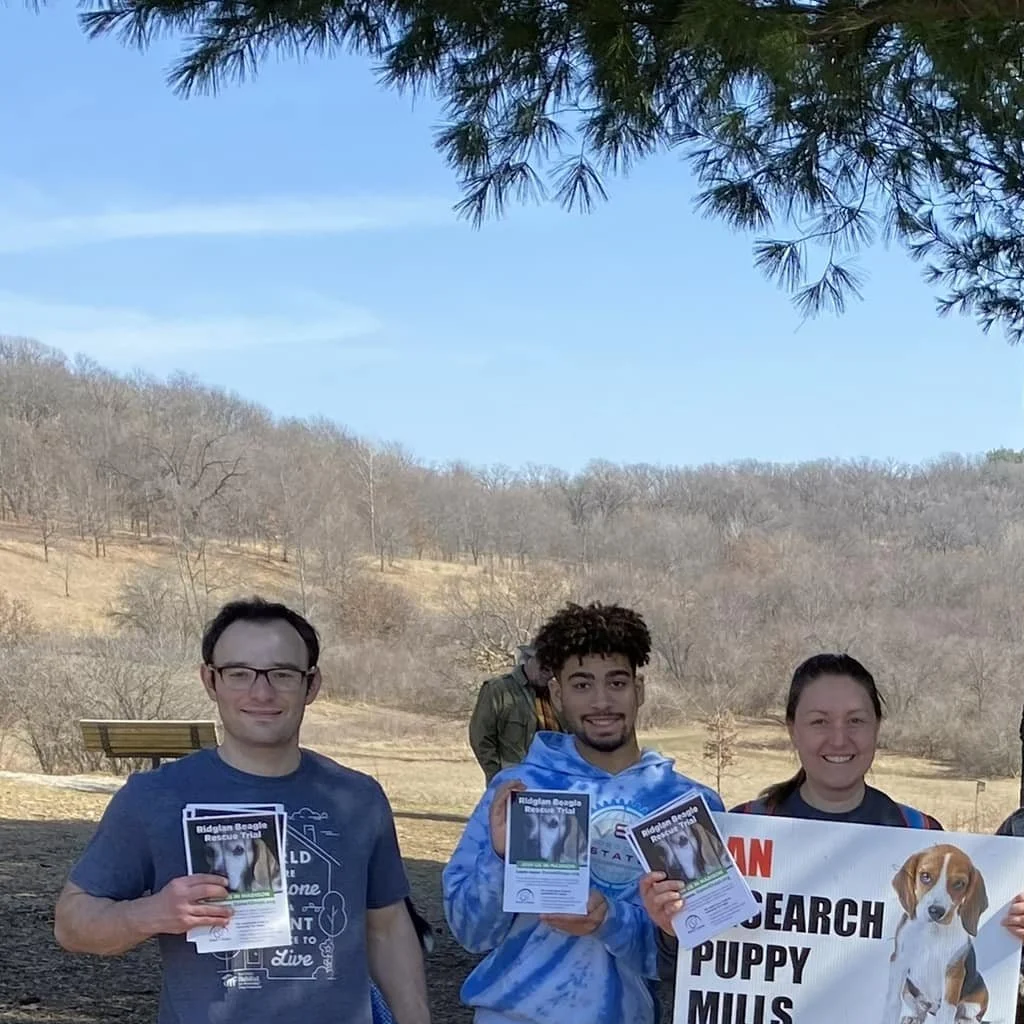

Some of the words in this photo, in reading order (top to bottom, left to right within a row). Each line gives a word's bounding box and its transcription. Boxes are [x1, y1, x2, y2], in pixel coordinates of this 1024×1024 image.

[590, 846, 641, 865] STAT
[727, 836, 773, 878] AN
[288, 884, 321, 895] one
[735, 890, 885, 939] SEARCH
[271, 950, 314, 966] Live
[690, 940, 811, 984] PUPPY
